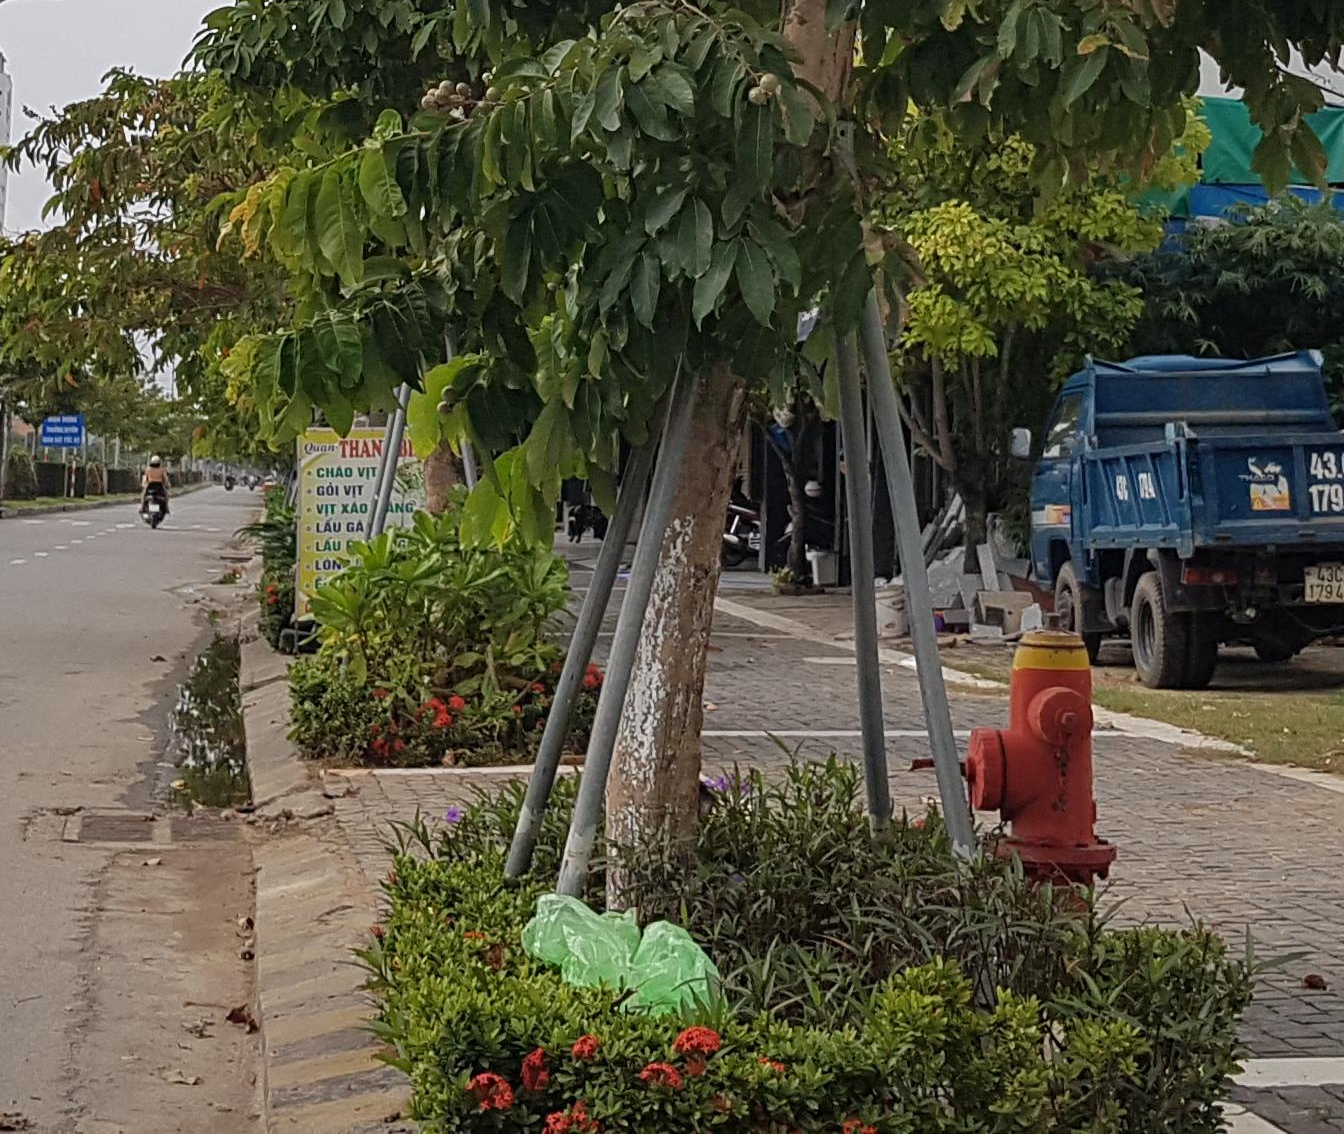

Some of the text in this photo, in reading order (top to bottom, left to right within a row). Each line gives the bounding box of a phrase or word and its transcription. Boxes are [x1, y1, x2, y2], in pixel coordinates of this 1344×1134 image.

[338, 439, 386, 459] THAN
[344, 485, 364, 499] VỊT
[1317, 566, 1343, 583] 43C
